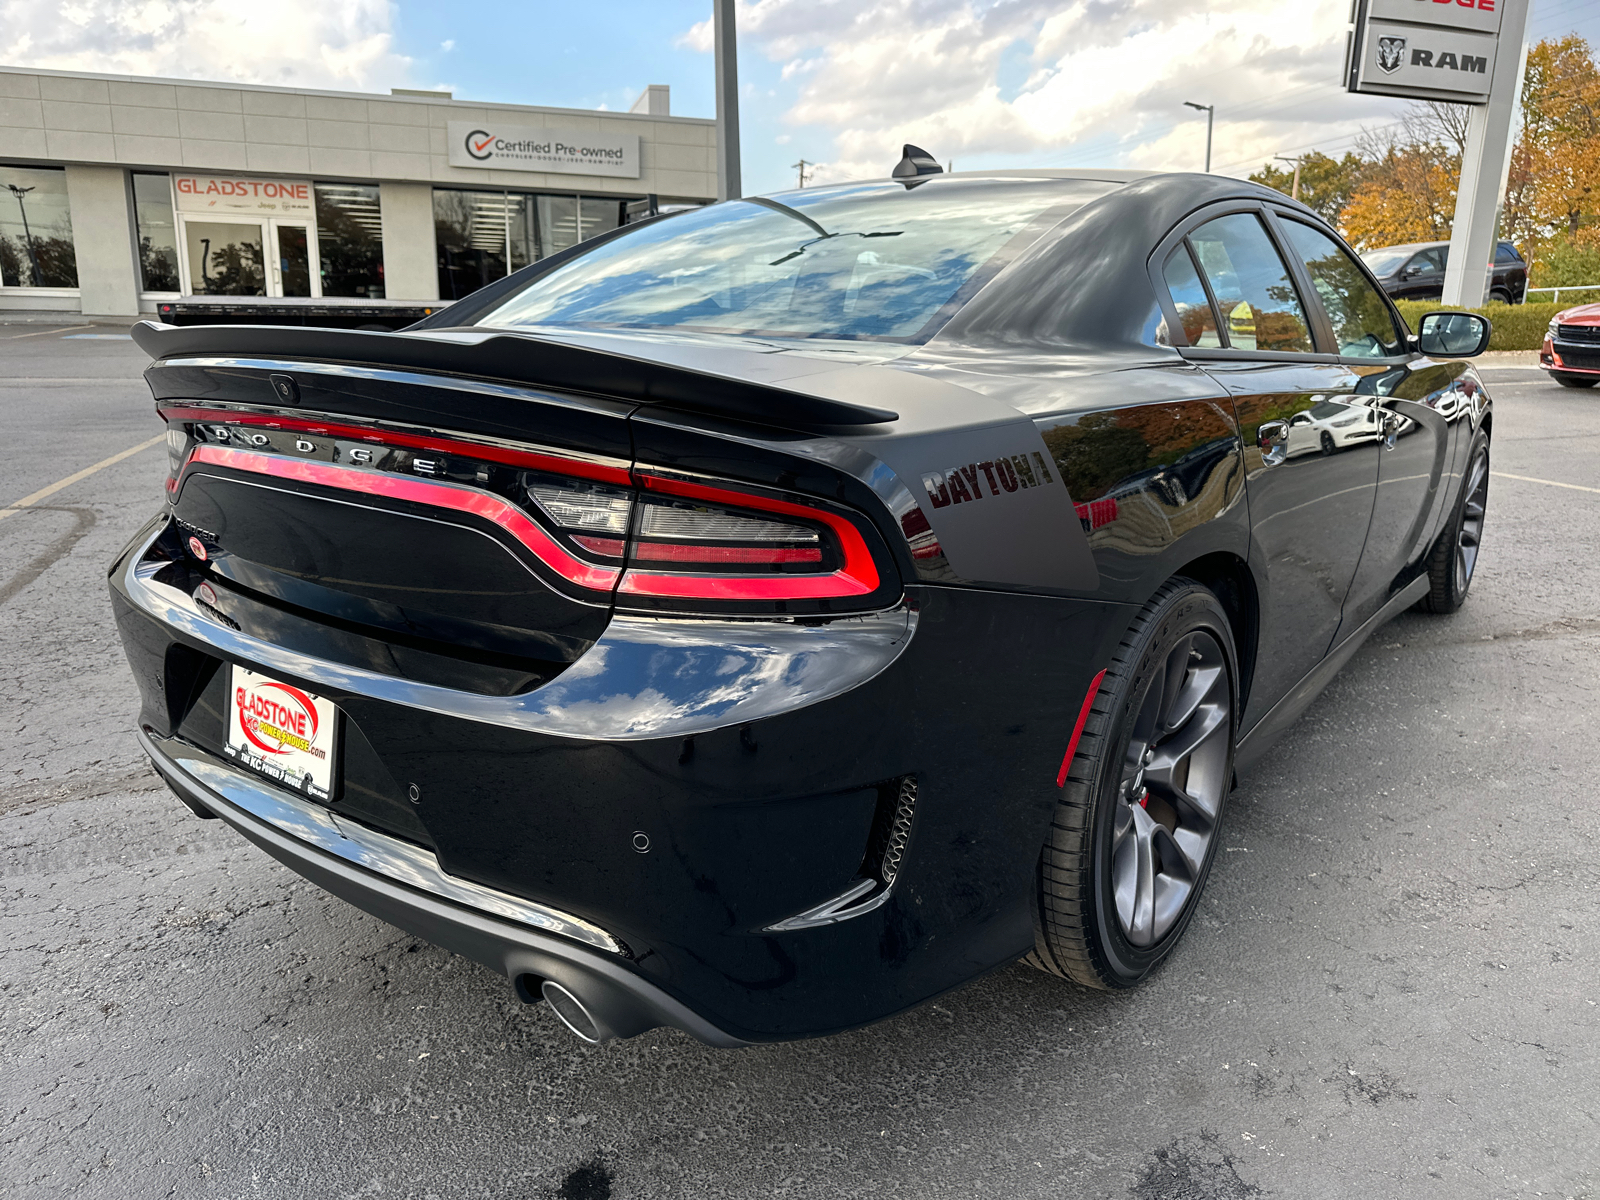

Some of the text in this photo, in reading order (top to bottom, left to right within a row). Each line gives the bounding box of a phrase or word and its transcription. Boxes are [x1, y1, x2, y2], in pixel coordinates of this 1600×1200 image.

[1410, 49, 1488, 74] RAM
[495, 139, 623, 159] Certified Pre-owned
[177, 178, 308, 199] GLADSTONE
[257, 201, 276, 210] Jeep
[215, 428, 438, 474] DODGE
[920, 451, 1053, 509] DAYTONA
[236, 686, 306, 737] GLADSTONE
[245, 715, 259, 732] KC
[259, 720, 281, 741] POWER
[250, 756, 262, 771] KC
[262, 763, 280, 779] POWER
[284, 772, 303, 790] HOUSE
